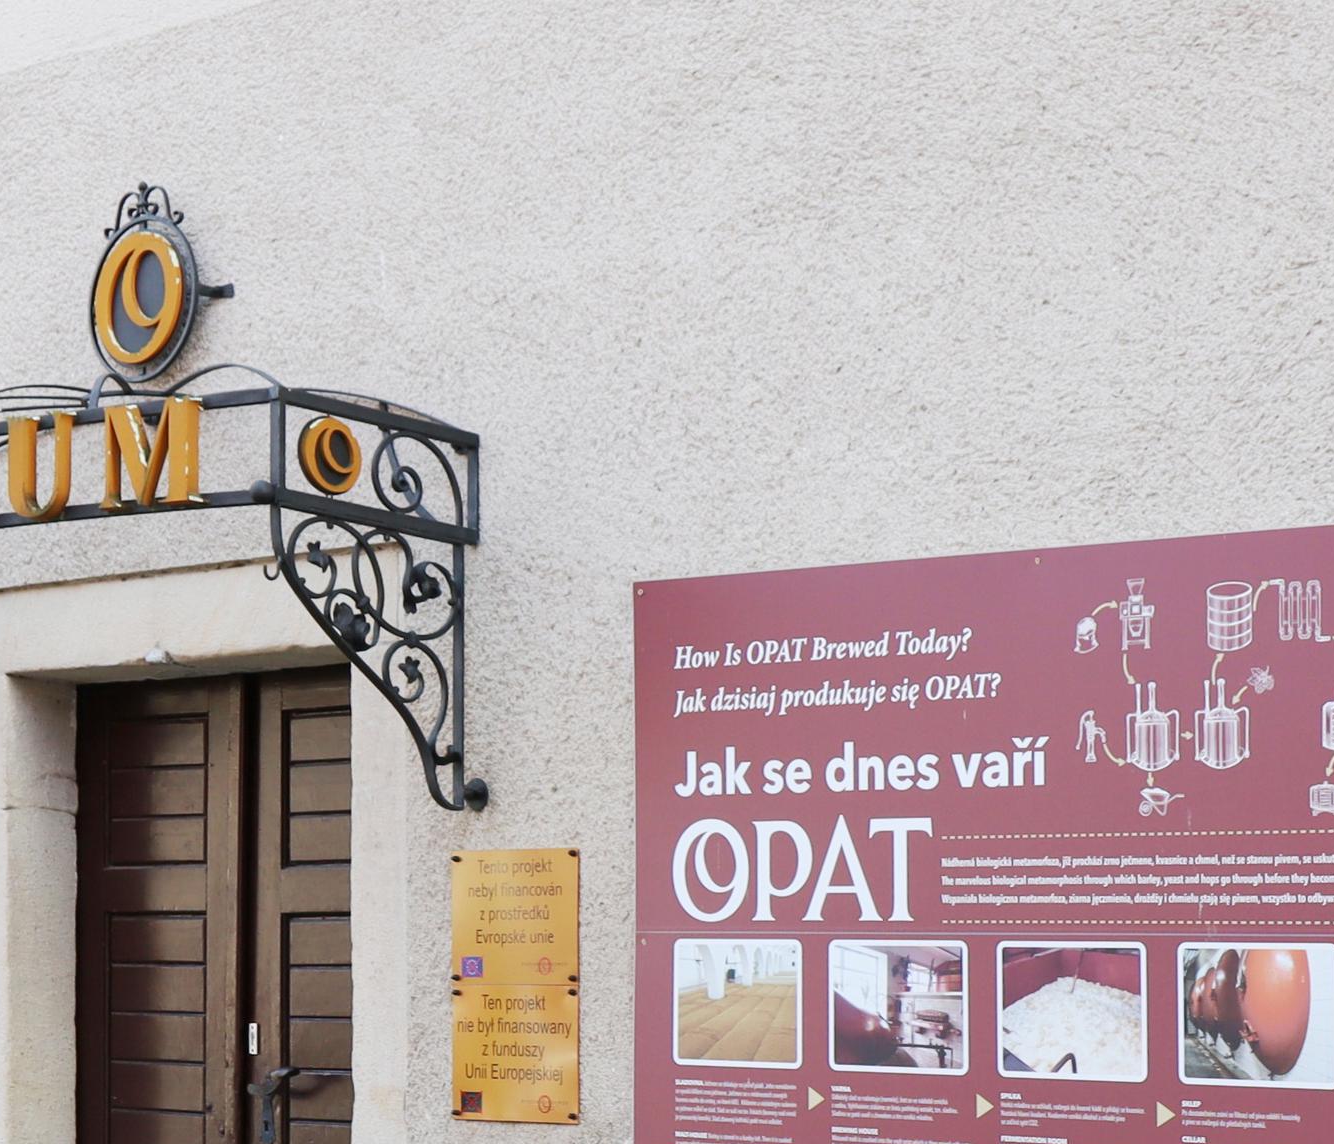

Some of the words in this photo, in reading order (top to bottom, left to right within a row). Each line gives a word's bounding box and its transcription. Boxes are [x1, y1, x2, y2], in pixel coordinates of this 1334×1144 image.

[674, 645, 719, 669] How
[724, 643, 741, 667] Is
[746, 638, 807, 665] OPAT
[811, 631, 889, 661] Brewed
[895, 627, 973, 661] Today?
[674, 690, 707, 717] Jak
[711, 684, 775, 716] dzisiaj
[779, 681, 887, 716] produkuje
[890, 681, 920, 708] się
[925, 672, 1002, 700] OPAT?
[674, 746, 752, 798] Jak
[762, 755, 812, 793] se
[825, 741, 940, 792] dnes
[952, 736, 1050, 788] vaří
[478, 860, 509, 874] Tento
[512, 859, 553, 878] projekt
[672, 814, 933, 922] OPAT
[468, 883, 498, 899] nebyl
[500, 882, 563, 897] financován
[480, 911, 485, 921] z
[488, 904, 550, 924] prostředků
[475, 929, 526, 947] Evropské
[530, 931, 555, 944] unie
[482, 995, 502, 1010] Ten
[506, 995, 546, 1015] projekt
[457, 1020, 474, 1033] nie
[477, 1019, 495, 1037] był
[497, 1019, 572, 1039] finansowany
[482, 1044, 489, 1056] z
[491, 1041, 545, 1060] funduszy
[465, 1063, 487, 1079] Unii
[490, 1063, 564, 1085] Europejskiej
